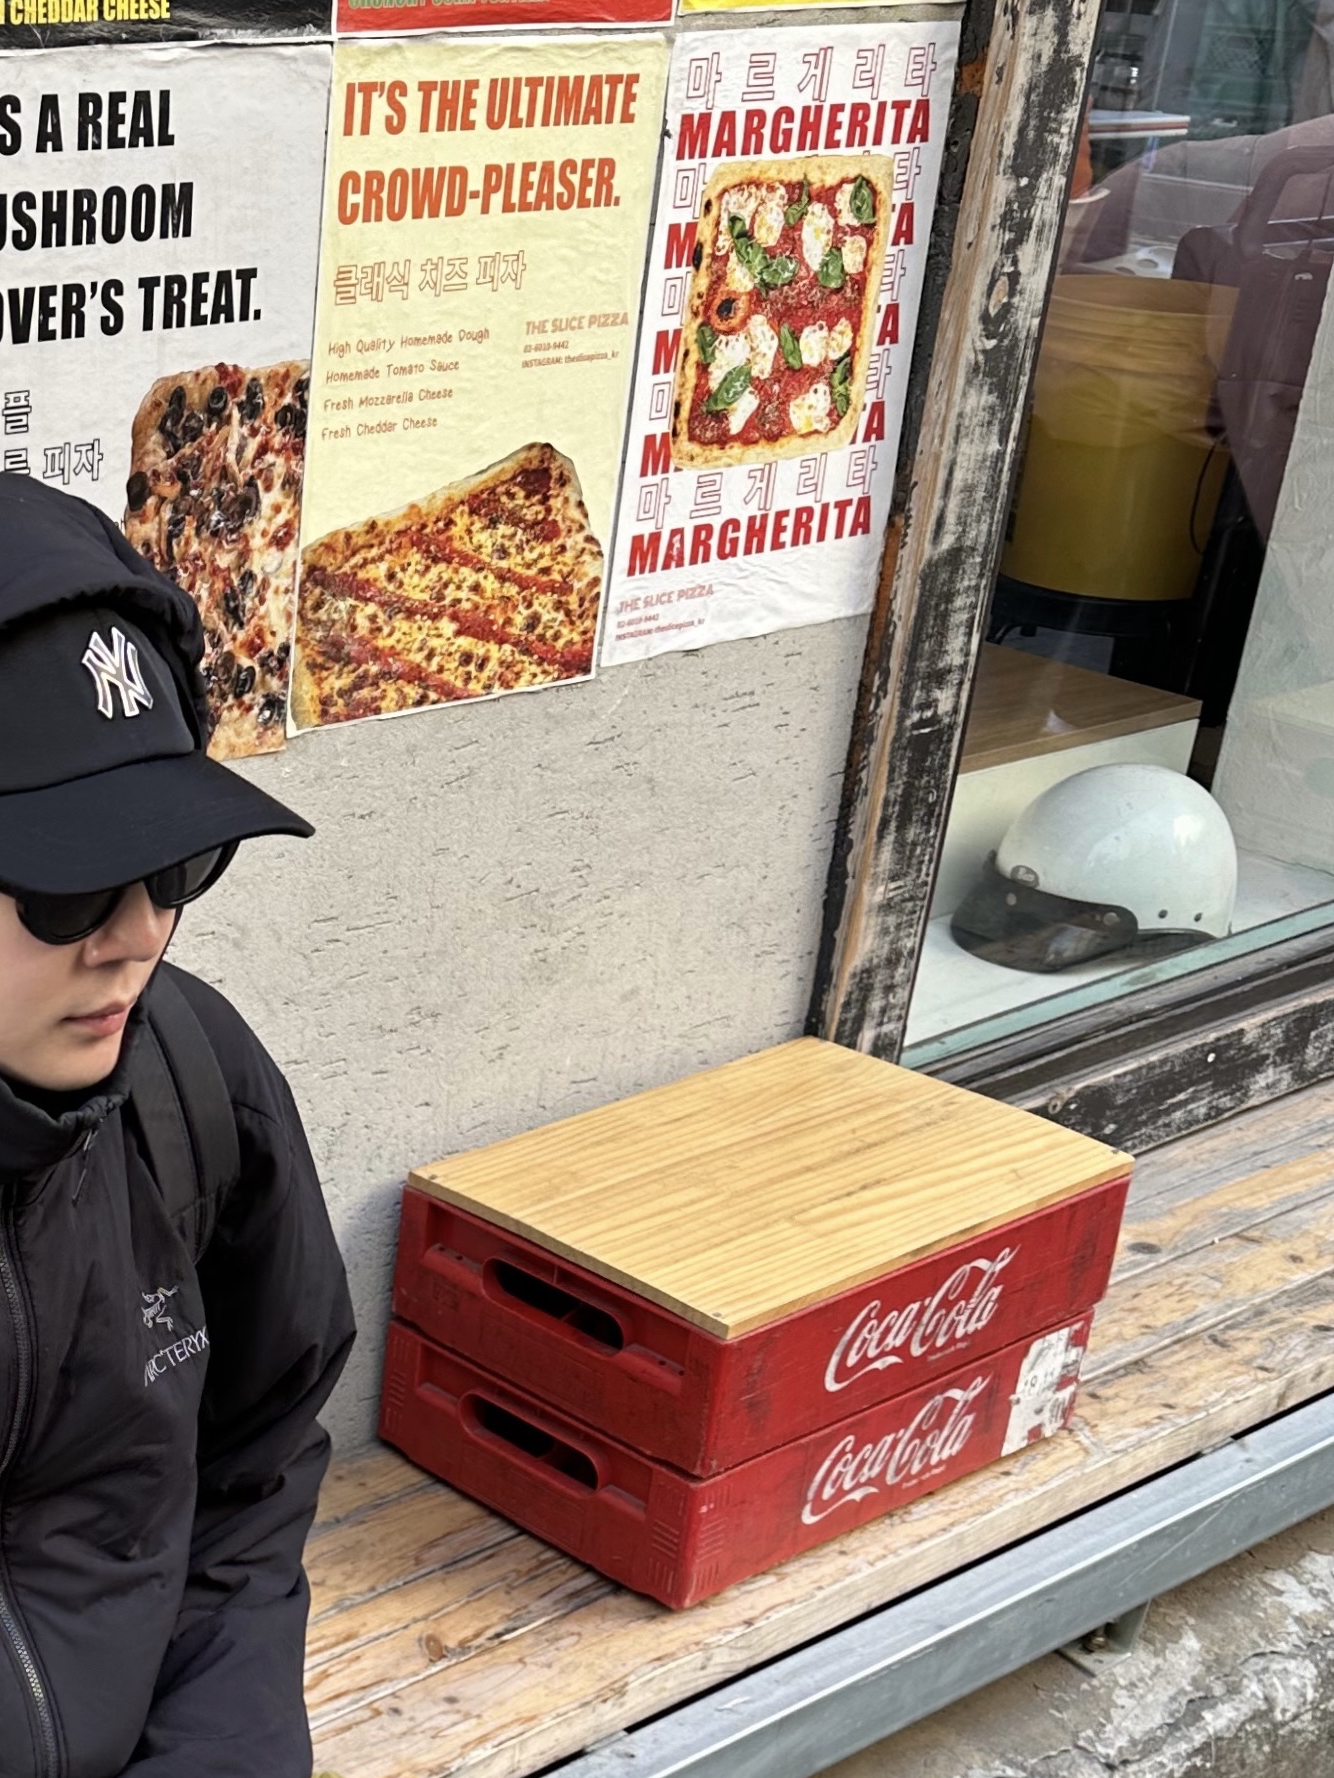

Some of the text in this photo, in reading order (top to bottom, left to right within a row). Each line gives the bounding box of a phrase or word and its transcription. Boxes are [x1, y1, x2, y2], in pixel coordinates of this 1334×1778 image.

[9, 0, 99, 25] CHEDDAR
[102, 0, 171, 21] CHEESE
[35, 93, 64, 155] A
[76, 89, 175, 152] REAL
[342, 72, 640, 137] IT'S THE ULTIMATE
[675, 98, 931, 161] MARGHERITA
[337, 157, 621, 226] CROWD-PLEASER.
[137, 267, 262, 332] TREAT.
[333, 250, 527, 306] 클래식 치즈 피자
[328, 327, 490, 358] High Quality Homemade Dough
[526, 312, 629, 336] THE SLICE PIZZA
[323, 387, 453, 412] Fresh Mozzarella Cheese
[326, 359, 460, 385] Homemade Tomato Sauce
[321, 416, 438, 441] Fresh Cheddar Cheese
[42, 438, 104, 485] 피자
[626, 495, 871, 577] MARGHERITA
[82, 626, 153, 719] NY
[824, 1243, 1022, 1393] Coca-Cola
[800, 1370, 995, 1526] Coca-Cola
